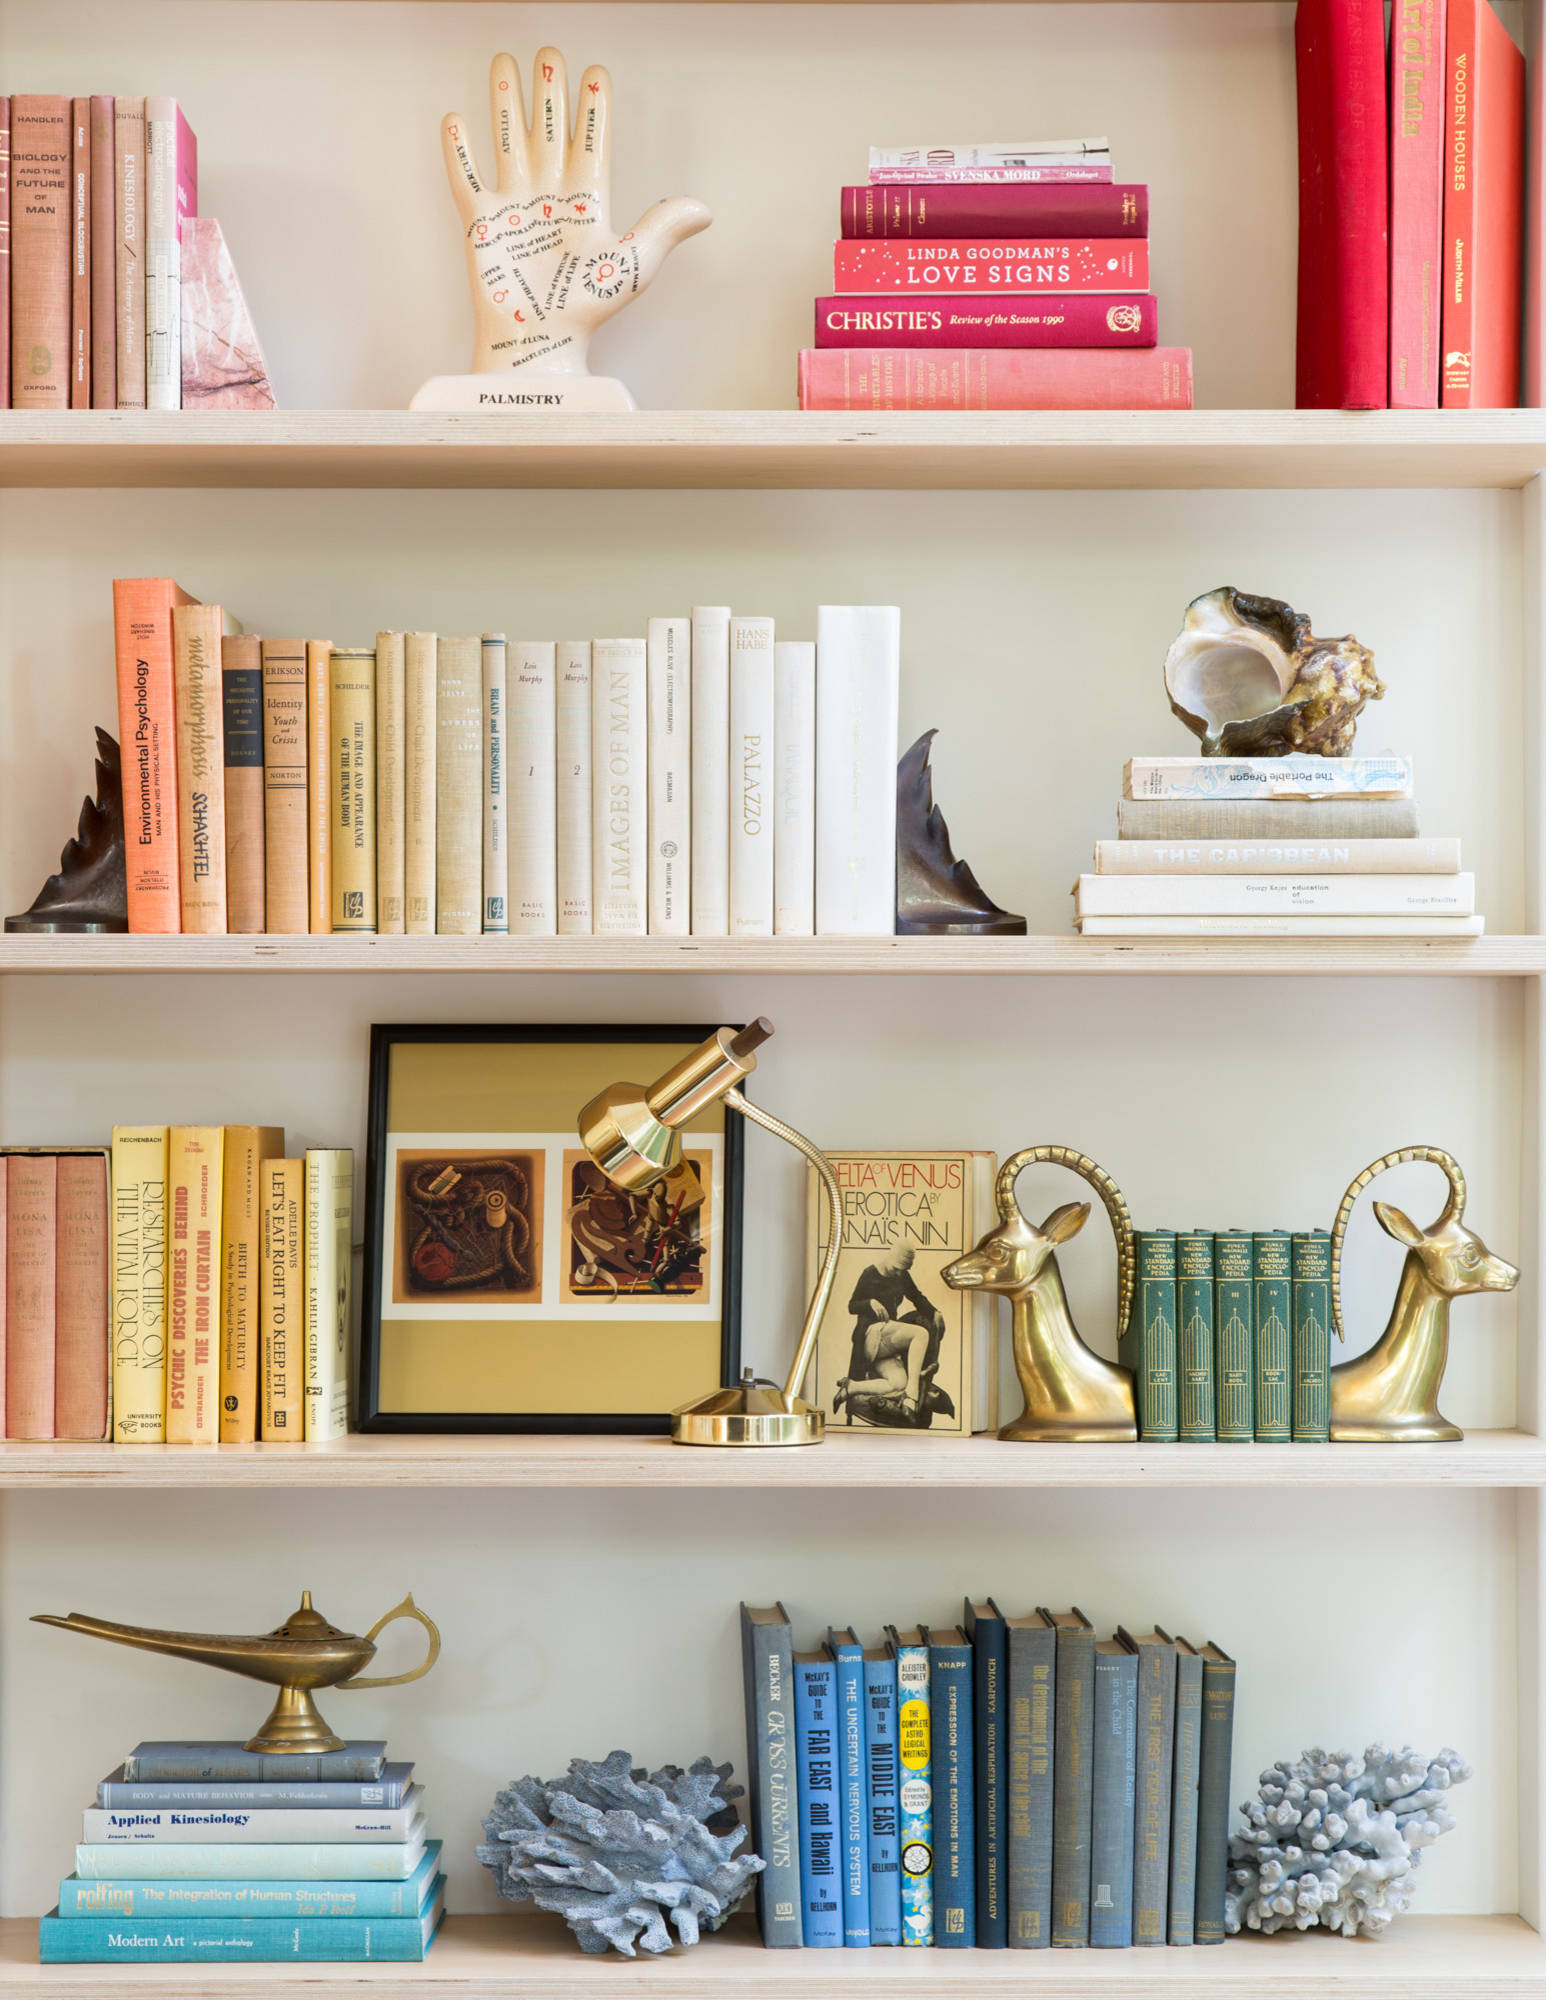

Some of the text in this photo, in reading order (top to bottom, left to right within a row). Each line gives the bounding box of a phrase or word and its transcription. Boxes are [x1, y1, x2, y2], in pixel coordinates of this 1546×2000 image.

[1402, 0, 1424, 137] Art of India
[500, 110, 510, 154] APOLLO
[545, 98, 555, 142] SATURN
[586, 107, 596, 152] JUPITER
[1454, 54, 1466, 191] WOODEN HOUSES
[16, 180, 65, 188] FUTURE
[456, 144, 482, 192] MERCURY
[944, 170, 1002, 180] SVENSKA
[1004, 169, 1042, 180] MORD
[26, 206, 56, 214] MAN
[125, 154, 135, 241] KINESIOLOGY
[506, 244, 525, 252] LINE
[534, 228, 562, 244] HEART
[512, 252, 530, 260] LINE
[541, 238, 563, 252] HEAD
[907, 247, 1070, 260] LINDA GOODMAN'S
[908, 265, 1070, 284] LOVE SIGNS
[1456, 238, 1464, 304] JUDITH MILLER
[827, 311, 1064, 330] CHRISTIE'S Review of the Season 1990
[479, 393, 564, 405] PALMISTRY
[266, 668, 304, 676] ERIKSON
[184, 634, 214, 780] metamorphosis
[268, 698, 304, 710] Identity
[273, 716, 297, 726] Youth
[610, 672, 630, 736] MAN
[134, 659, 152, 845] Environmental Psychology
[272, 735, 298, 744] Crisis
[490, 688, 500, 796] BRAIN and PERSONALITY
[610, 742, 630, 776] OF
[340, 738, 350, 828] OF THE HUMAN BODY
[354, 721, 364, 848] THE IMAGE AND APPEARANCE
[743, 735, 762, 836] PALAZZO
[1230, 772, 1334, 782] The Portable Dragon
[192, 792, 209, 882] SCHACHTEL
[610, 784, 630, 892] IMAGES
[1154, 848, 1350, 864] THE CARIBBEAN
[872, 1162, 887, 1174] OF
[887, 1163, 961, 1189] VENUS
[845, 1192, 941, 1217] EROTICA BY
[116, 1184, 139, 1367] THE VITAL FORCE
[142, 1181, 164, 1369] RESEARCHES ON
[196, 1230, 211, 1292] CURTAIN
[289, 1240, 297, 1268] DAVIS
[309, 1162, 320, 1380] THE PROPHET KAHLIL GIBRAN
[171, 1186, 188, 1410] PSYCHIC DISCOVERIES BEHIND
[237, 1243, 248, 1370] BIRTH TO MATURITY
[272, 1172, 286, 1398] LET'S EAT RIGHT TO KEEP FIT
[196, 1296, 210, 1333] IRON
[195, 1340, 209, 1366] THE
[768, 1654, 781, 1701] BECKER
[938, 1661, 967, 1669] KNAPP
[808, 1730, 834, 1876] FAR EAST and Hawaii
[846, 1678, 861, 1895] THE UNCERTAIN NERVOUS SYSTEM
[871, 1744, 894, 1836] MIDDLE EAST
[949, 1686, 959, 1877] EXPRESSION OF THE EMOTIONS IN MAN
[988, 1658, 998, 1919] ADVENTURES IN ARTIFICIAL RESPIRATION KARPOVICH
[107, 1814, 250, 1826] Applied Kinesiology
[771, 1772, 792, 1868] CURRENTS
[76, 1883, 356, 1915] rolfing The Integration of Human Structures
[108, 1934, 185, 1948] Modern Art
